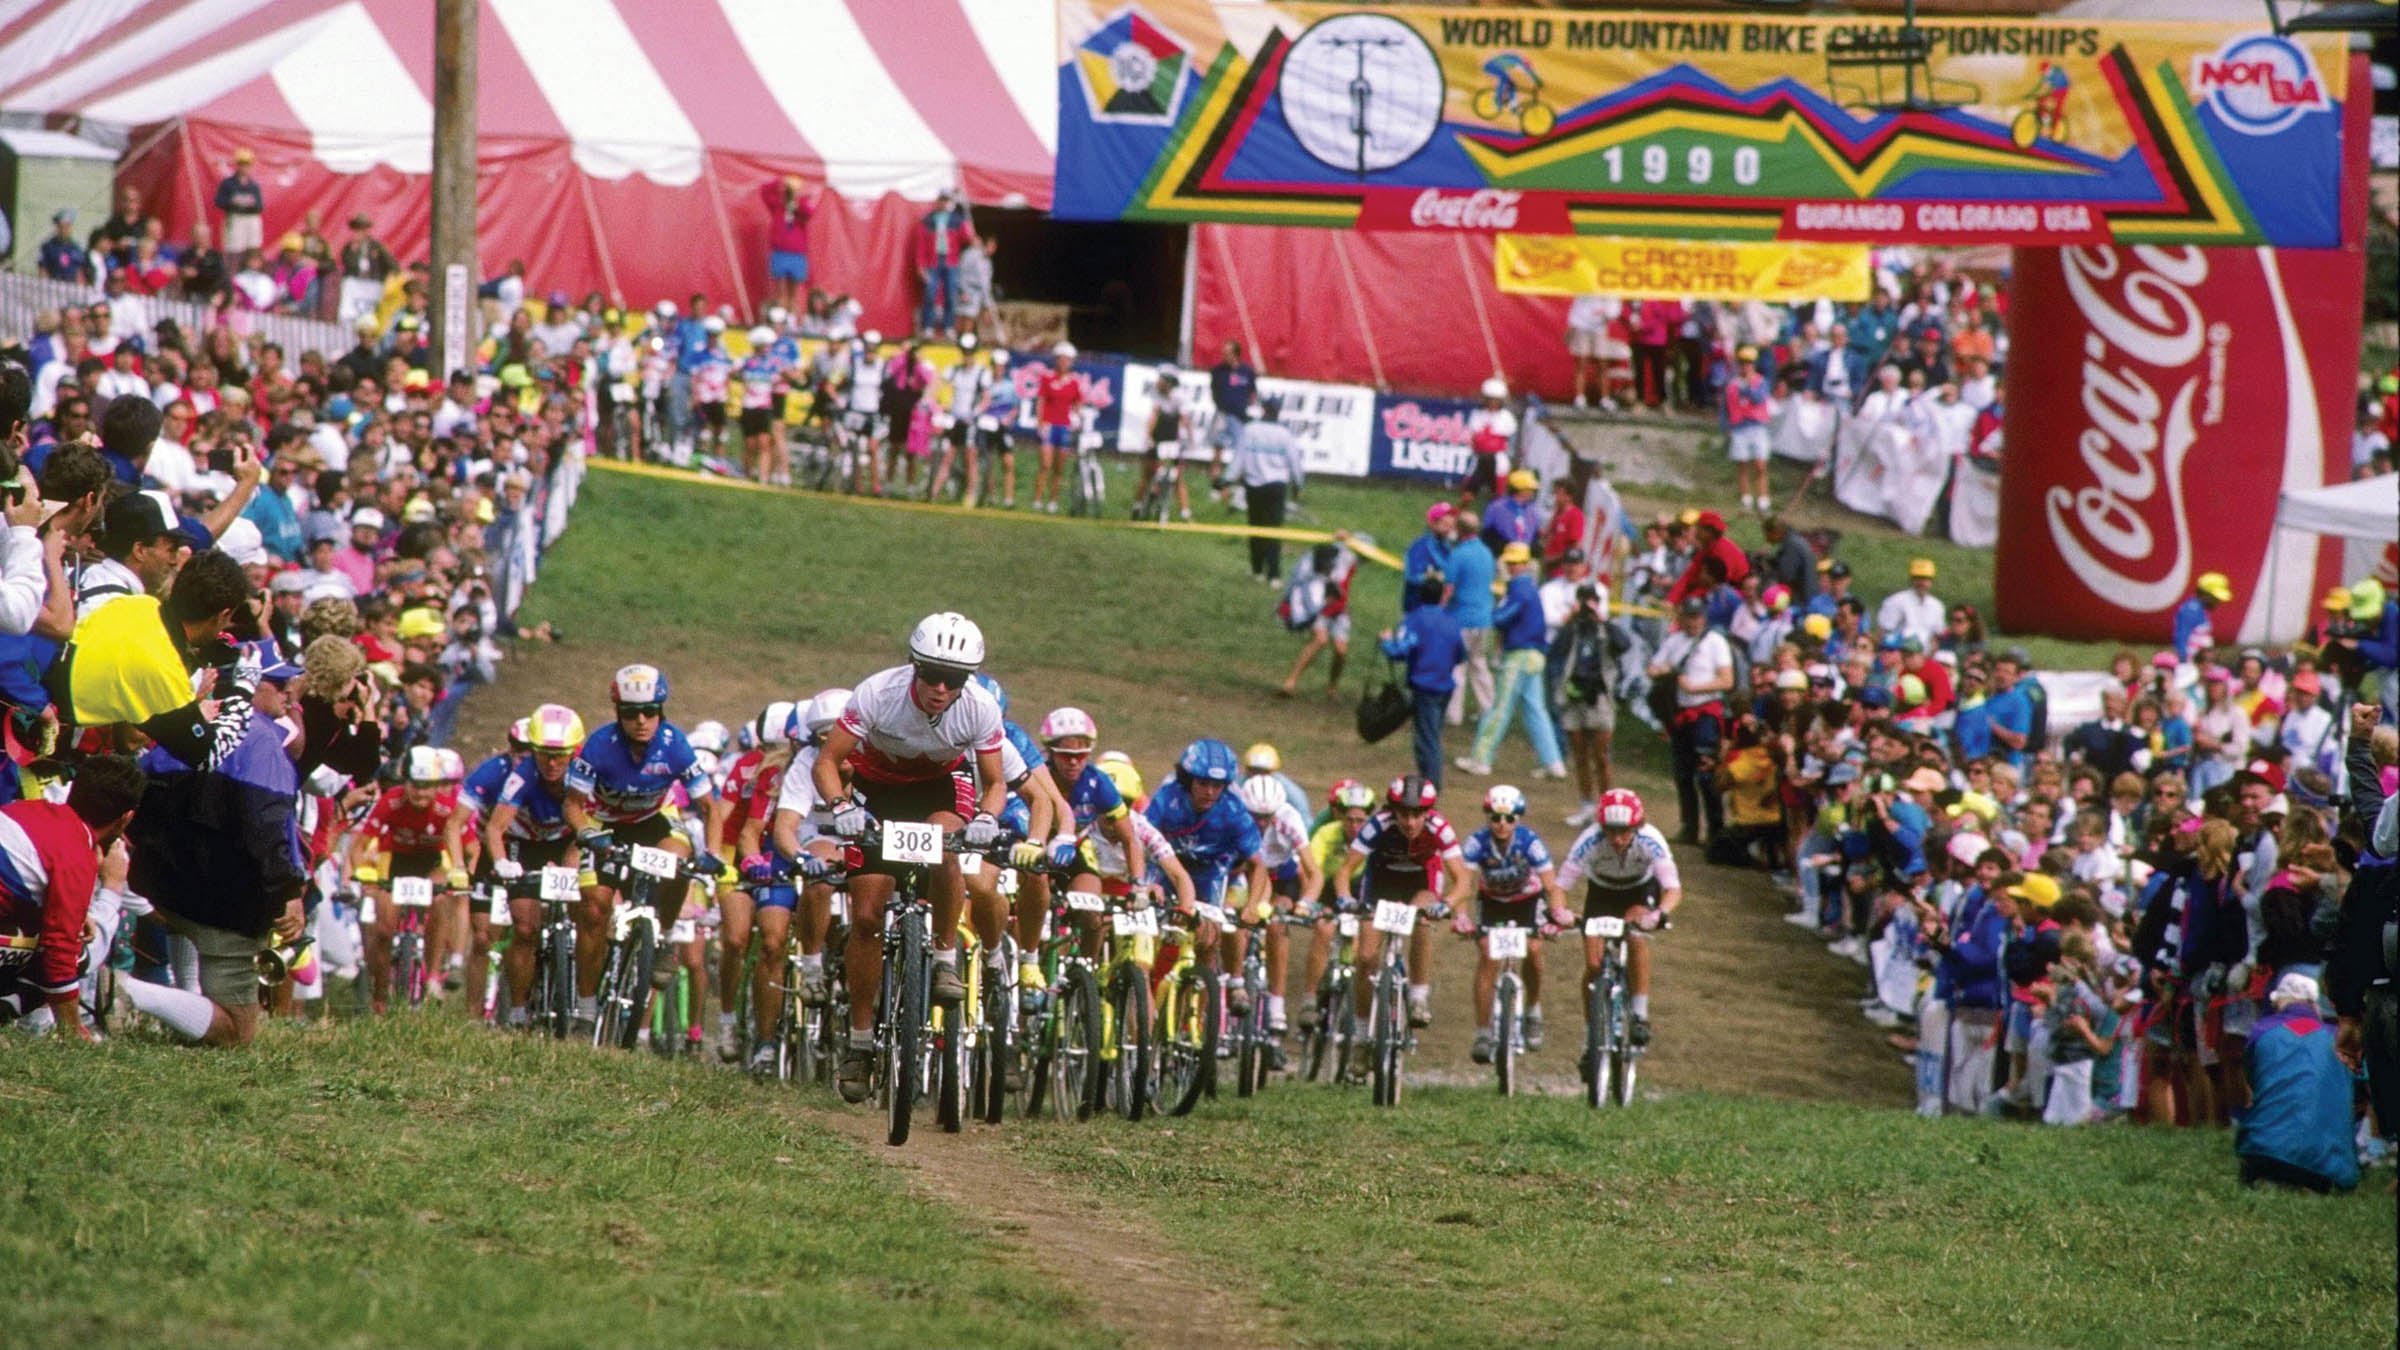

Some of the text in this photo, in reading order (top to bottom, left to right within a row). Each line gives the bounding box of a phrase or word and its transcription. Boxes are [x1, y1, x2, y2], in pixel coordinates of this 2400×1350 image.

[1441, 18, 1551, 47] WORLD
[1567, 20, 1730, 50] MOUNTAIN
[1743, 24, 1816, 53] BIKE
[1603, 145, 1760, 185] 1990
[1410, 187, 1523, 228] Coca-Cola
[1796, 203, 2093, 232] DURANGO COLORADO USA
[1621, 247, 1739, 266] CROSS
[1600, 268, 1756, 291] COUNTRY
[1391, 439, 1473, 475] LIGHT
[893, 830, 932, 852] 308
[640, 851, 669, 869] 323
[550, 873, 579, 891] 302
